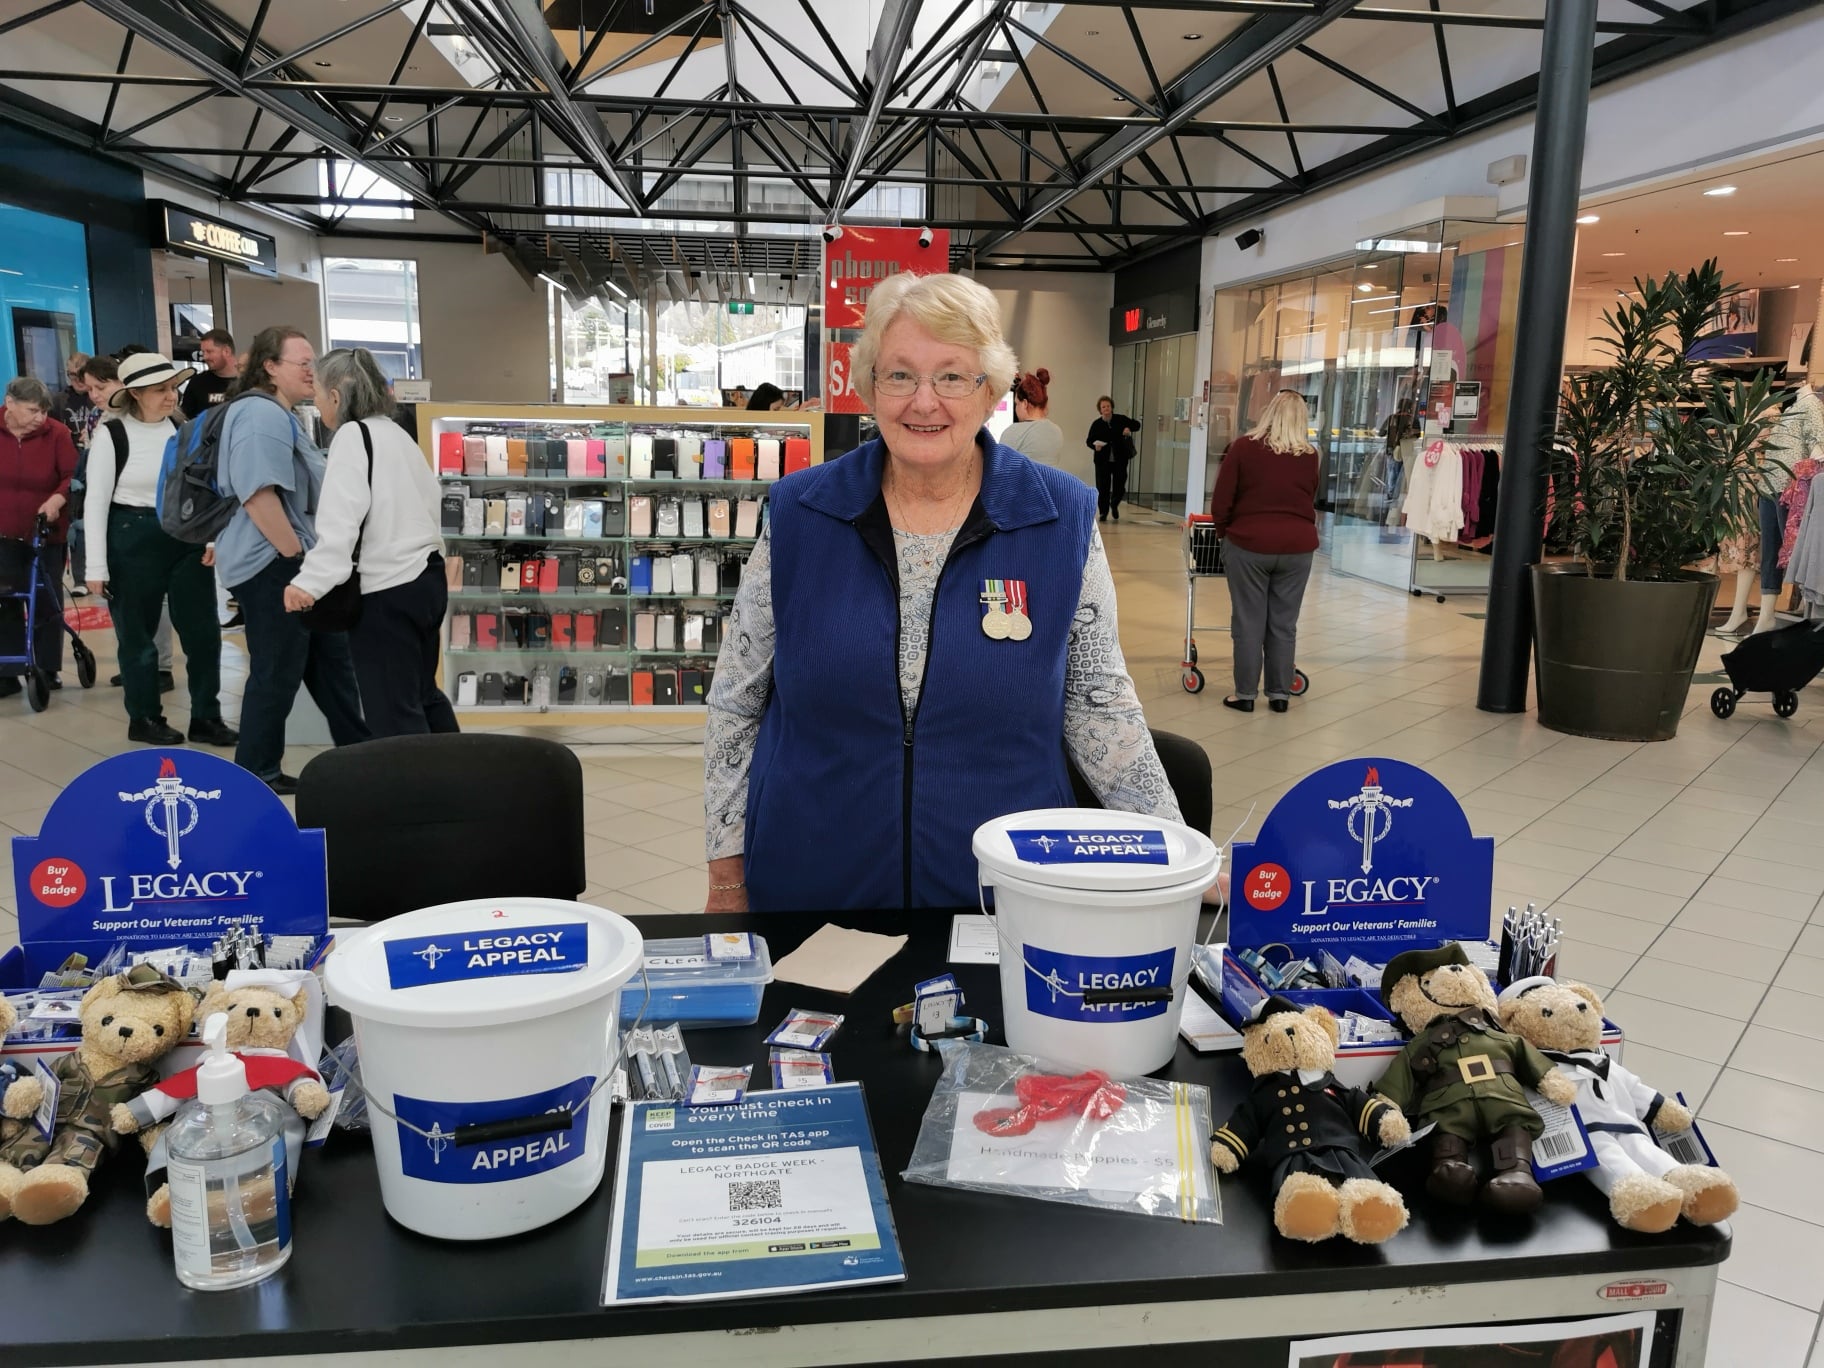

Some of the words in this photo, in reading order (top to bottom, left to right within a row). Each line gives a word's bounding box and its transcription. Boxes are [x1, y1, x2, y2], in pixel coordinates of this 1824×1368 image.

[207, 224, 241, 254] COFFEE
[1067, 834, 1144, 843] LEGACY
[1074, 845, 1150, 855] APPEAL
[47, 865, 69, 876] Buy
[1259, 870, 1277, 880] Buy
[55, 877, 62, 885] a
[42, 885, 77, 895] Badge
[1253, 889, 1282, 899] Badge
[92, 919, 138, 931] Support
[139, 918, 162, 928] Our
[163, 916, 216, 928] Veterans’
[1291, 922, 1330, 934] Support
[1332, 921, 1350, 931] Our
[1352, 919, 1397, 930] Veterans’
[1397, 918, 1437, 928] Families
[464, 931, 564, 951] LEGACY
[467, 947, 566, 968] APPEAL
[649, 957, 705, 965] CLEA
[1078, 966, 1160, 990] LEGACY
[688, 1106, 719, 1114] You
[723, 1101, 764, 1111] must
[768, 1097, 814, 1108] check
[817, 1096, 832, 1104] in
[688, 1112, 735, 1122] every
[741, 1110, 778, 1119] time
[672, 1139, 703, 1147] Open
[706, 1137, 725, 1145] the
[728, 1134, 764, 1143] Check
[781, 1131, 805, 1139] TAS
[808, 1130, 830, 1138] app
[739, 1142, 759, 1150] the
[762, 1141, 779, 1149] QR
[783, 1139, 811, 1147] code
[471, 1131, 570, 1170] APPEAL
[680, 1164, 731, 1174] LEGACY
[735, 1161, 777, 1170] BADGE
[782, 1158, 817, 1167] WEEK
[1154, 1157, 1174, 1166] $5
[714, 1168, 793, 1179] NORTHGATE
[733, 1217, 781, 1226] 326104
[635, 1271, 722, 1283] www.checkin.tas.gov.au
[1608, 1286, 1629, 1296] MALL
